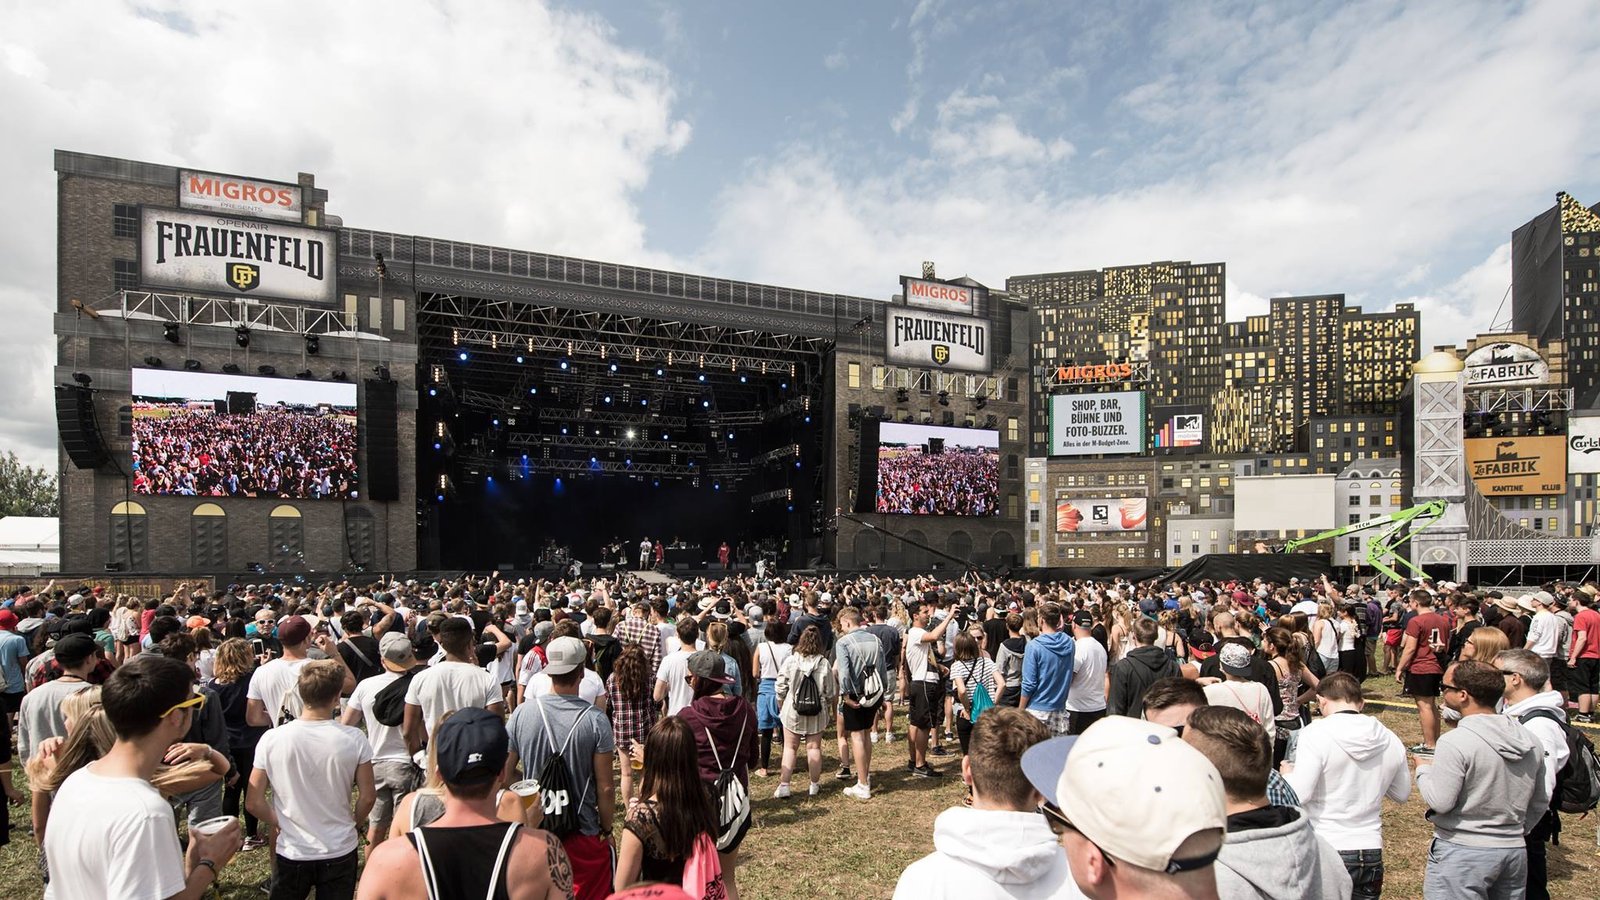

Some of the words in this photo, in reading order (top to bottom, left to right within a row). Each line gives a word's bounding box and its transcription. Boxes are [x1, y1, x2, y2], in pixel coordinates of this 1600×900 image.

[190, 177, 293, 207] MIGROS
[220, 201, 263, 213] PRESENTS
[216, 218, 270, 231] OPENAIR
[156, 220, 324, 281] FRAUENFELD
[911, 283, 968, 303] MIGROS
[894, 315, 985, 356] FRAUENFELD
[1058, 362, 1132, 380] MIGROS
[1480, 363, 1535, 380] FABRIK
[1071, 400, 1097, 412] SHOP,
[1100, 398, 1121, 411] BAR,
[1071, 411, 1101, 424] BÜHNE
[1103, 411, 1122, 423] UND
[1176, 416, 1200, 430] MTV
[1066, 425, 1128, 437] FOTO-BUZZER.
[1091, 439, 1131, 447] M-Budget-Zone.
[1485, 460, 1537, 475] FABRIK
[1492, 484, 1524, 492] KANTINE
